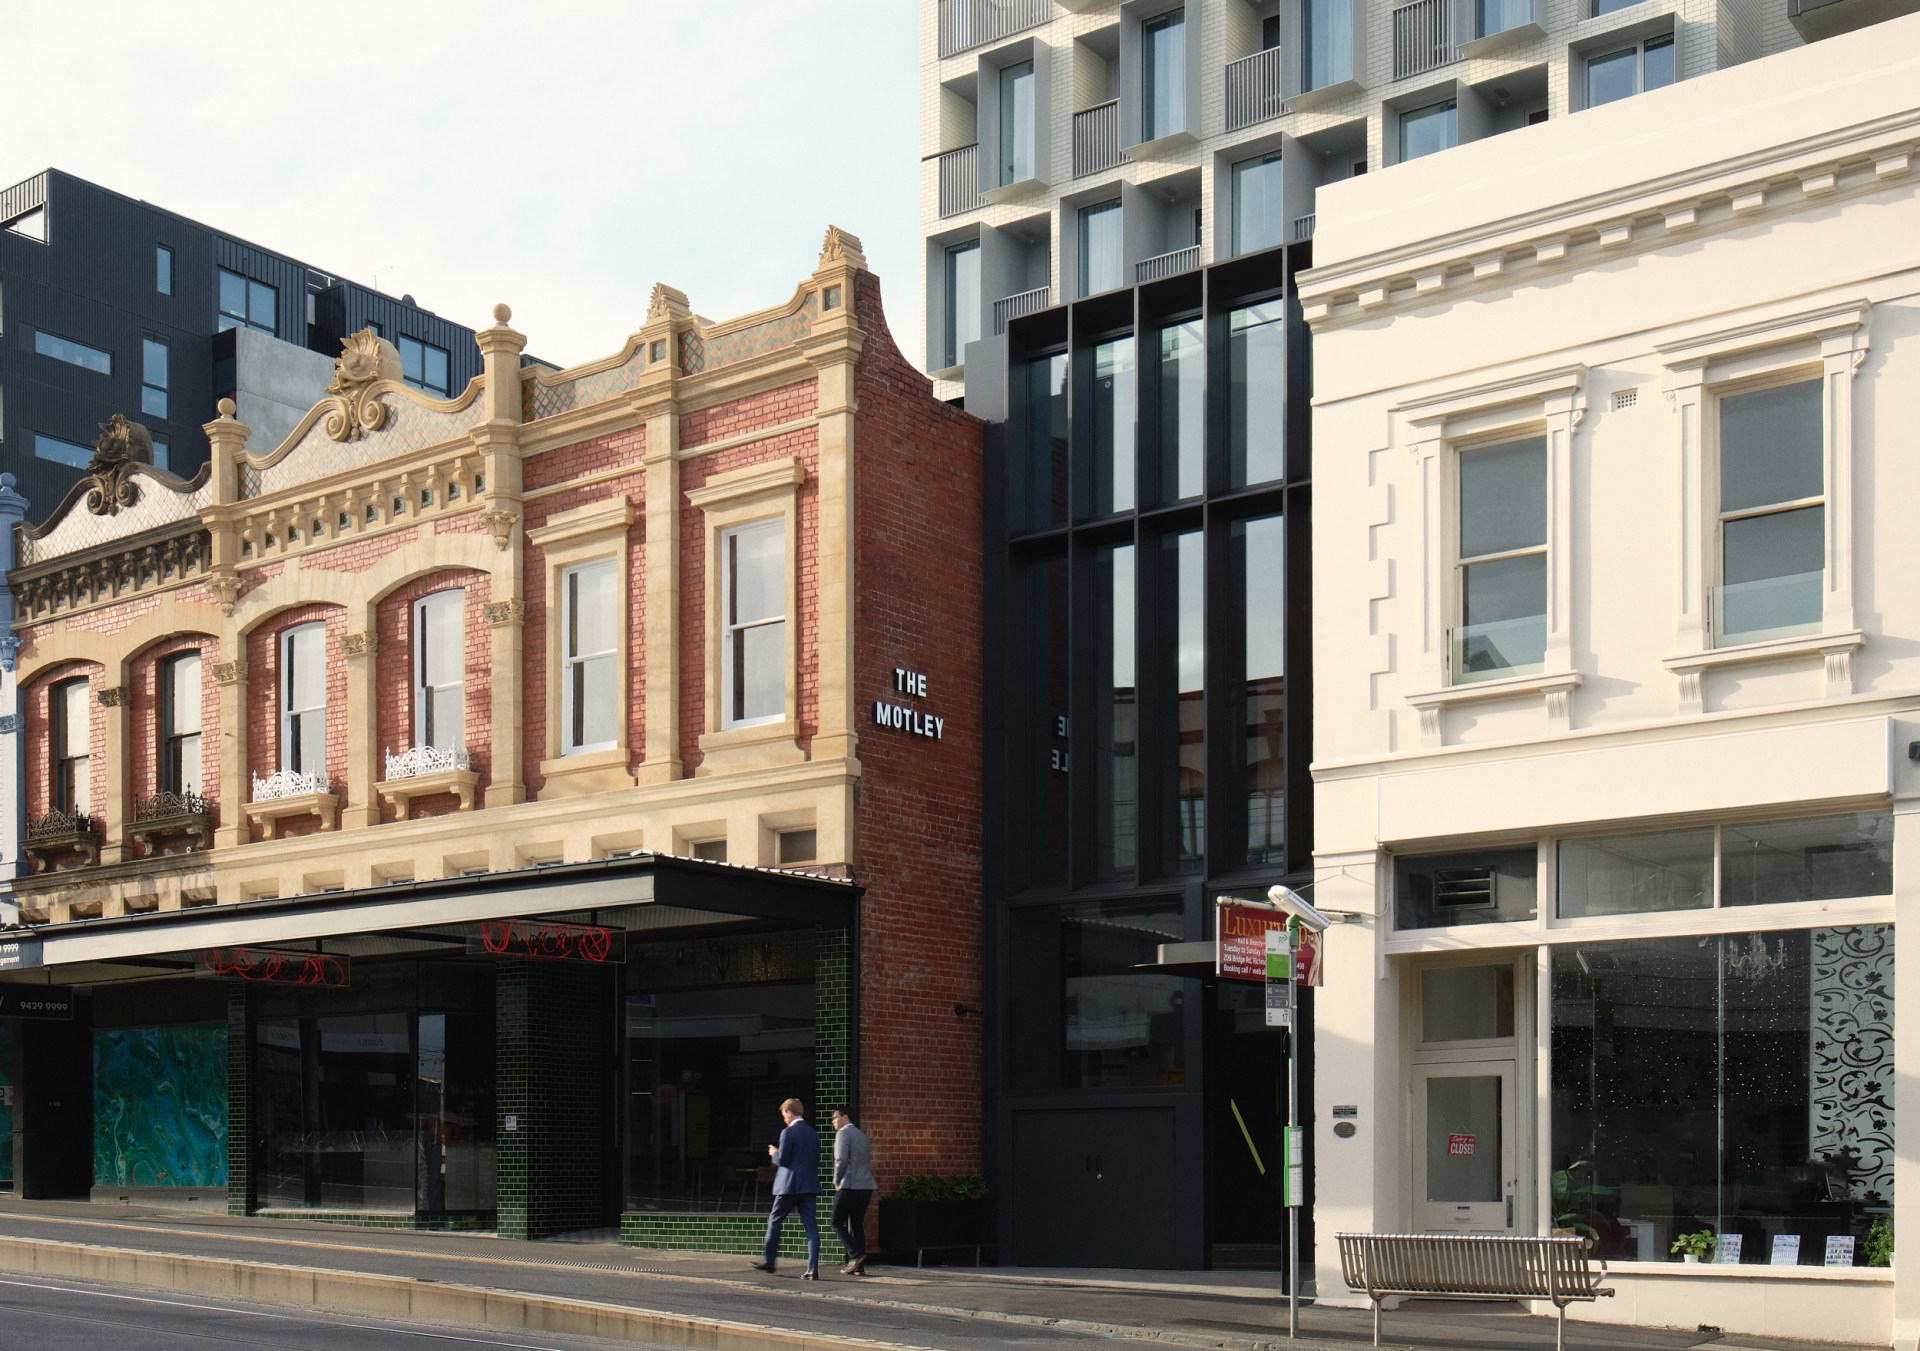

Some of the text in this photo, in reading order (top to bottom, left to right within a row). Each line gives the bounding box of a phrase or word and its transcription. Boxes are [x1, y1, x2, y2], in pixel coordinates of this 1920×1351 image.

[896, 668, 927, 697] THE
[876, 701, 944, 740] MOTLEY
[3, 943, 19, 953] 9999
[1224, 944, 1240, 954] Tuesday
[1246, 946, 1261, 956] Sunday
[1232, 955, 1246, 964] Bridge
[1224, 964, 1240, 974] Booking
[20, 1001, 68, 1011] 9429 9999
[1283, 1013, 1289, 1023] 17
[1451, 1143, 1475, 1154] CLOSED
